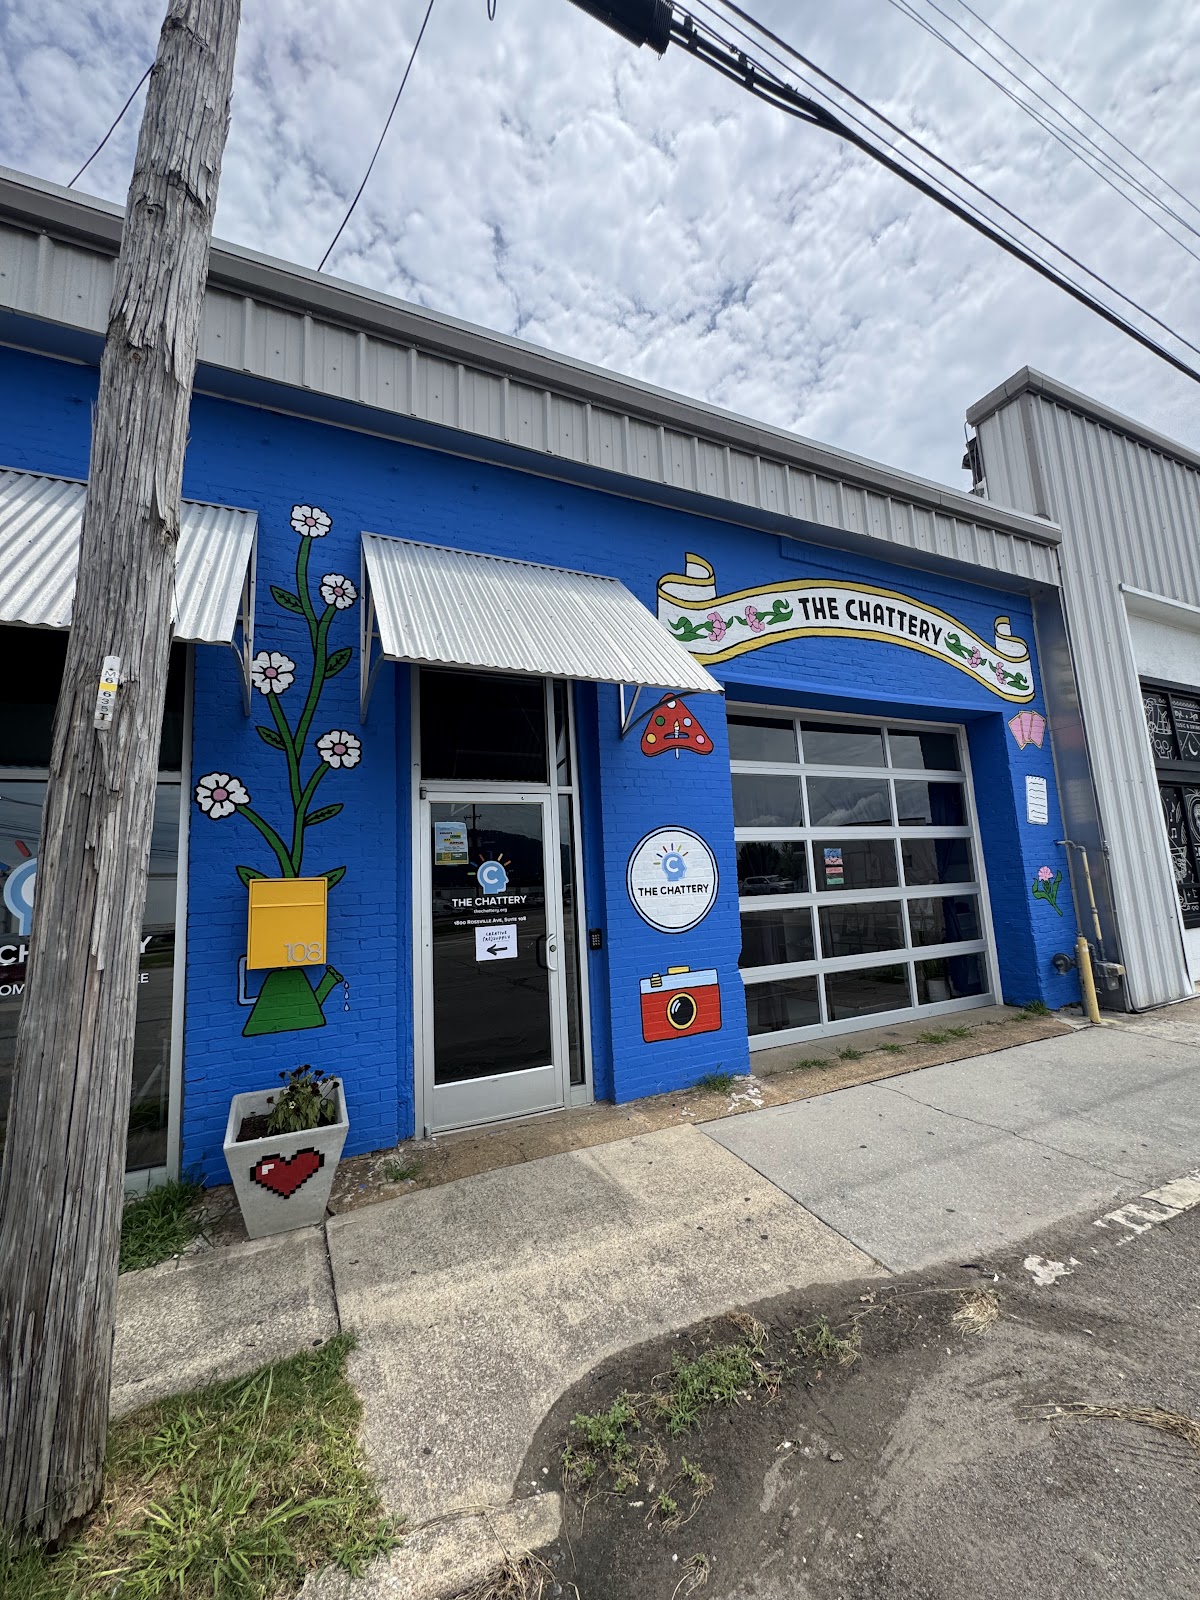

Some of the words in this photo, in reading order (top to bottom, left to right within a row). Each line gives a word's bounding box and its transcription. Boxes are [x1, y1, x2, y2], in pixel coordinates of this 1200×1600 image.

[798, 597, 840, 621] THE
[845, 598, 943, 645] CHATTERY
[665, 856, 679, 873] C
[482, 866, 499, 885] C
[637, 887, 658, 896] THE
[660, 884, 709, 895] CHATTERY
[451, 897, 473, 908] THE
[474, 895, 527, 906] CHATTERY
[284, 941, 322, 963] 108
